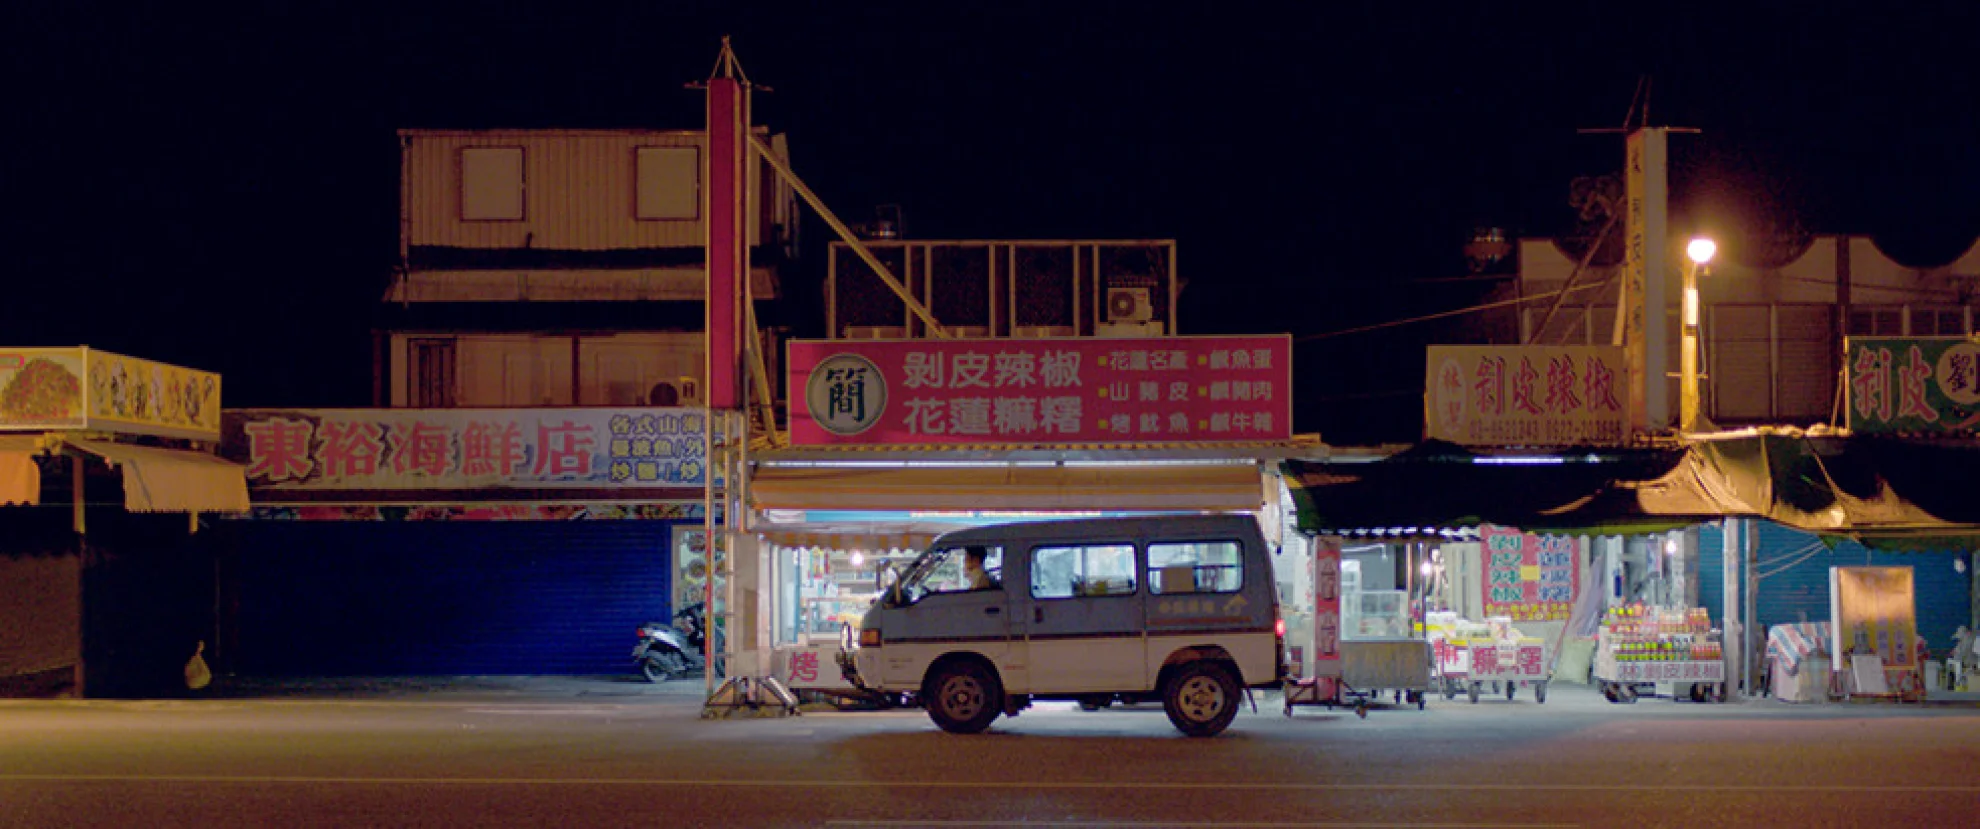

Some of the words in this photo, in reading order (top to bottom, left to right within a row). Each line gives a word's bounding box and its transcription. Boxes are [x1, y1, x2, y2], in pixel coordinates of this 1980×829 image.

[902, 350, 1082, 389] 剝皮辣椒
[1110, 349, 1189, 370] 花蓮名產
[826, 367, 867, 422] 簡
[1110, 380, 1189, 402] 山豬皮
[1475, 354, 1622, 416] 剝皮辣椒
[1854, 344, 1939, 423] 剝皮
[611, 414, 724, 435] 各式山海
[249, 418, 596, 479] 東裕海鮮店
